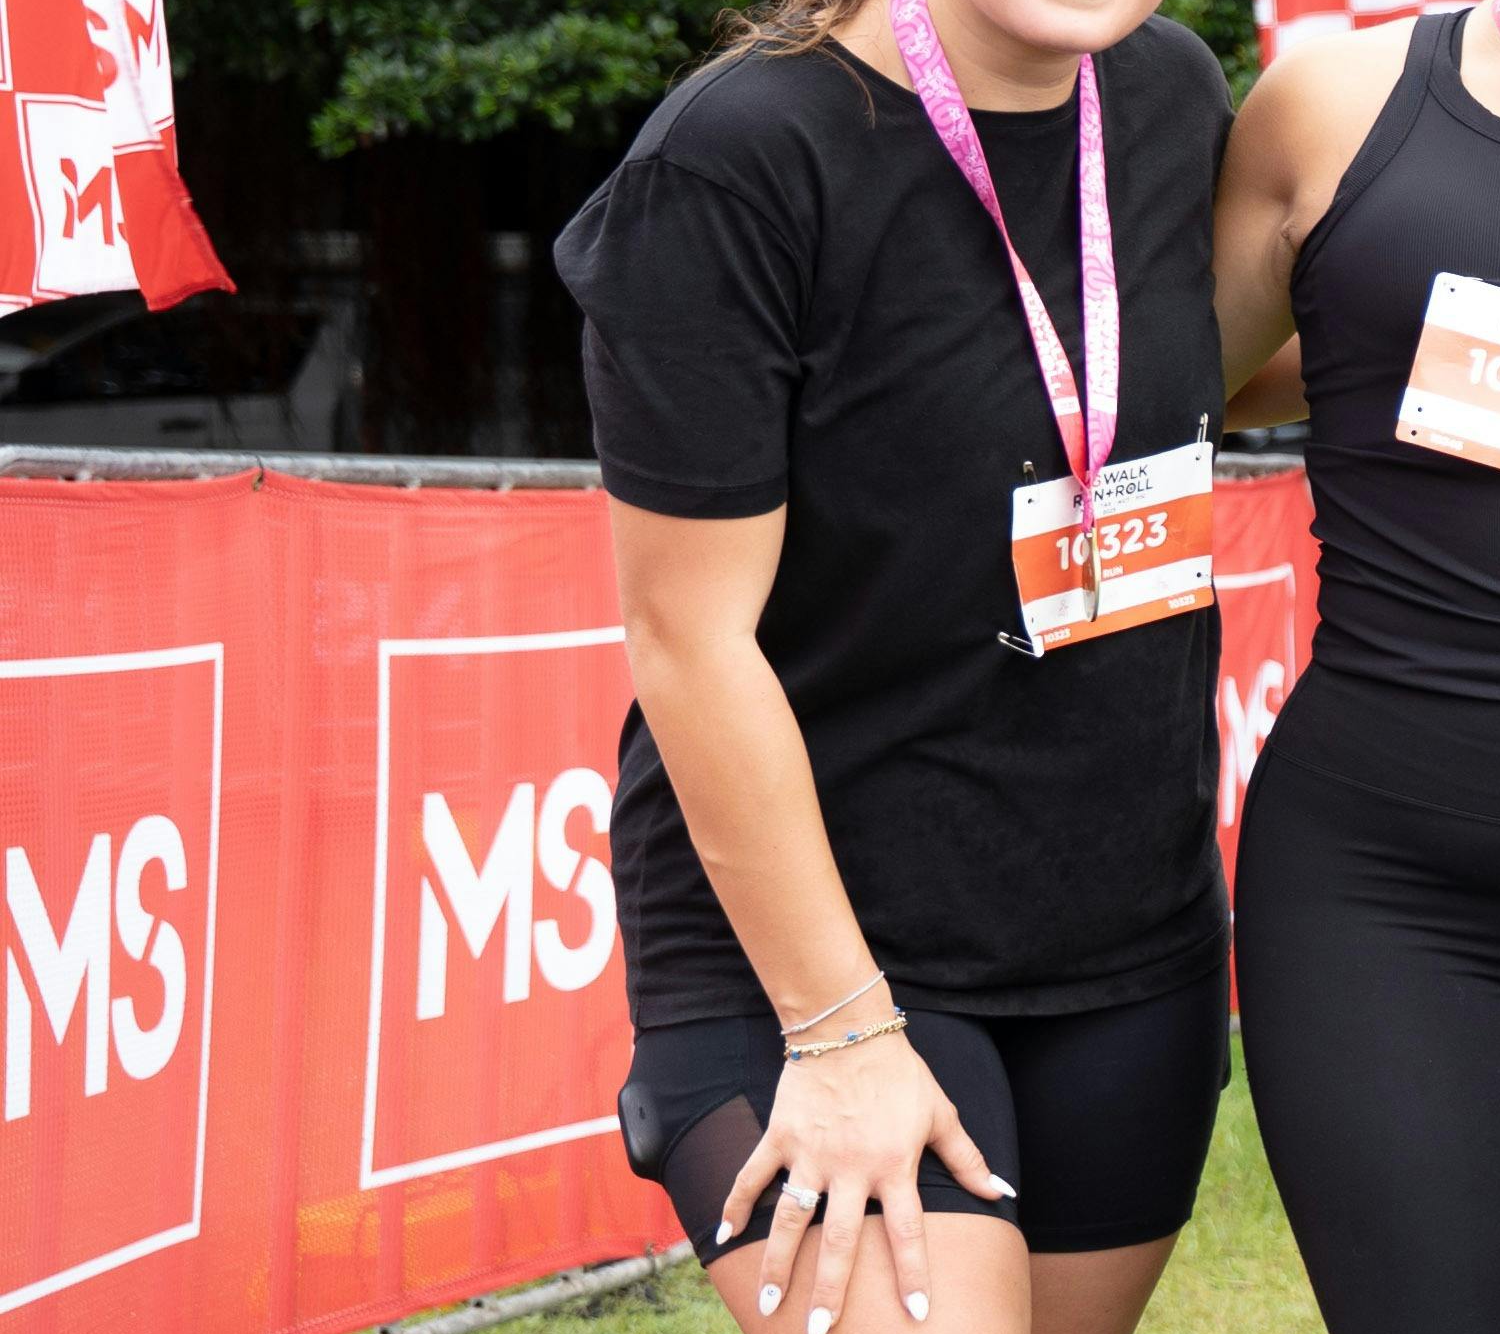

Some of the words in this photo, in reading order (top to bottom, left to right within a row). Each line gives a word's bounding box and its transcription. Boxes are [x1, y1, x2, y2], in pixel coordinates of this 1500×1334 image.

[1072, 479, 1154, 509] RN+ROLL
[1104, 463, 1148, 485] WALK
[1056, 511, 1169, 571] 10323
[1102, 565, 1124, 578] RUN
[416, 767, 619, 1021] MS
[5, 814, 188, 1122] MS
